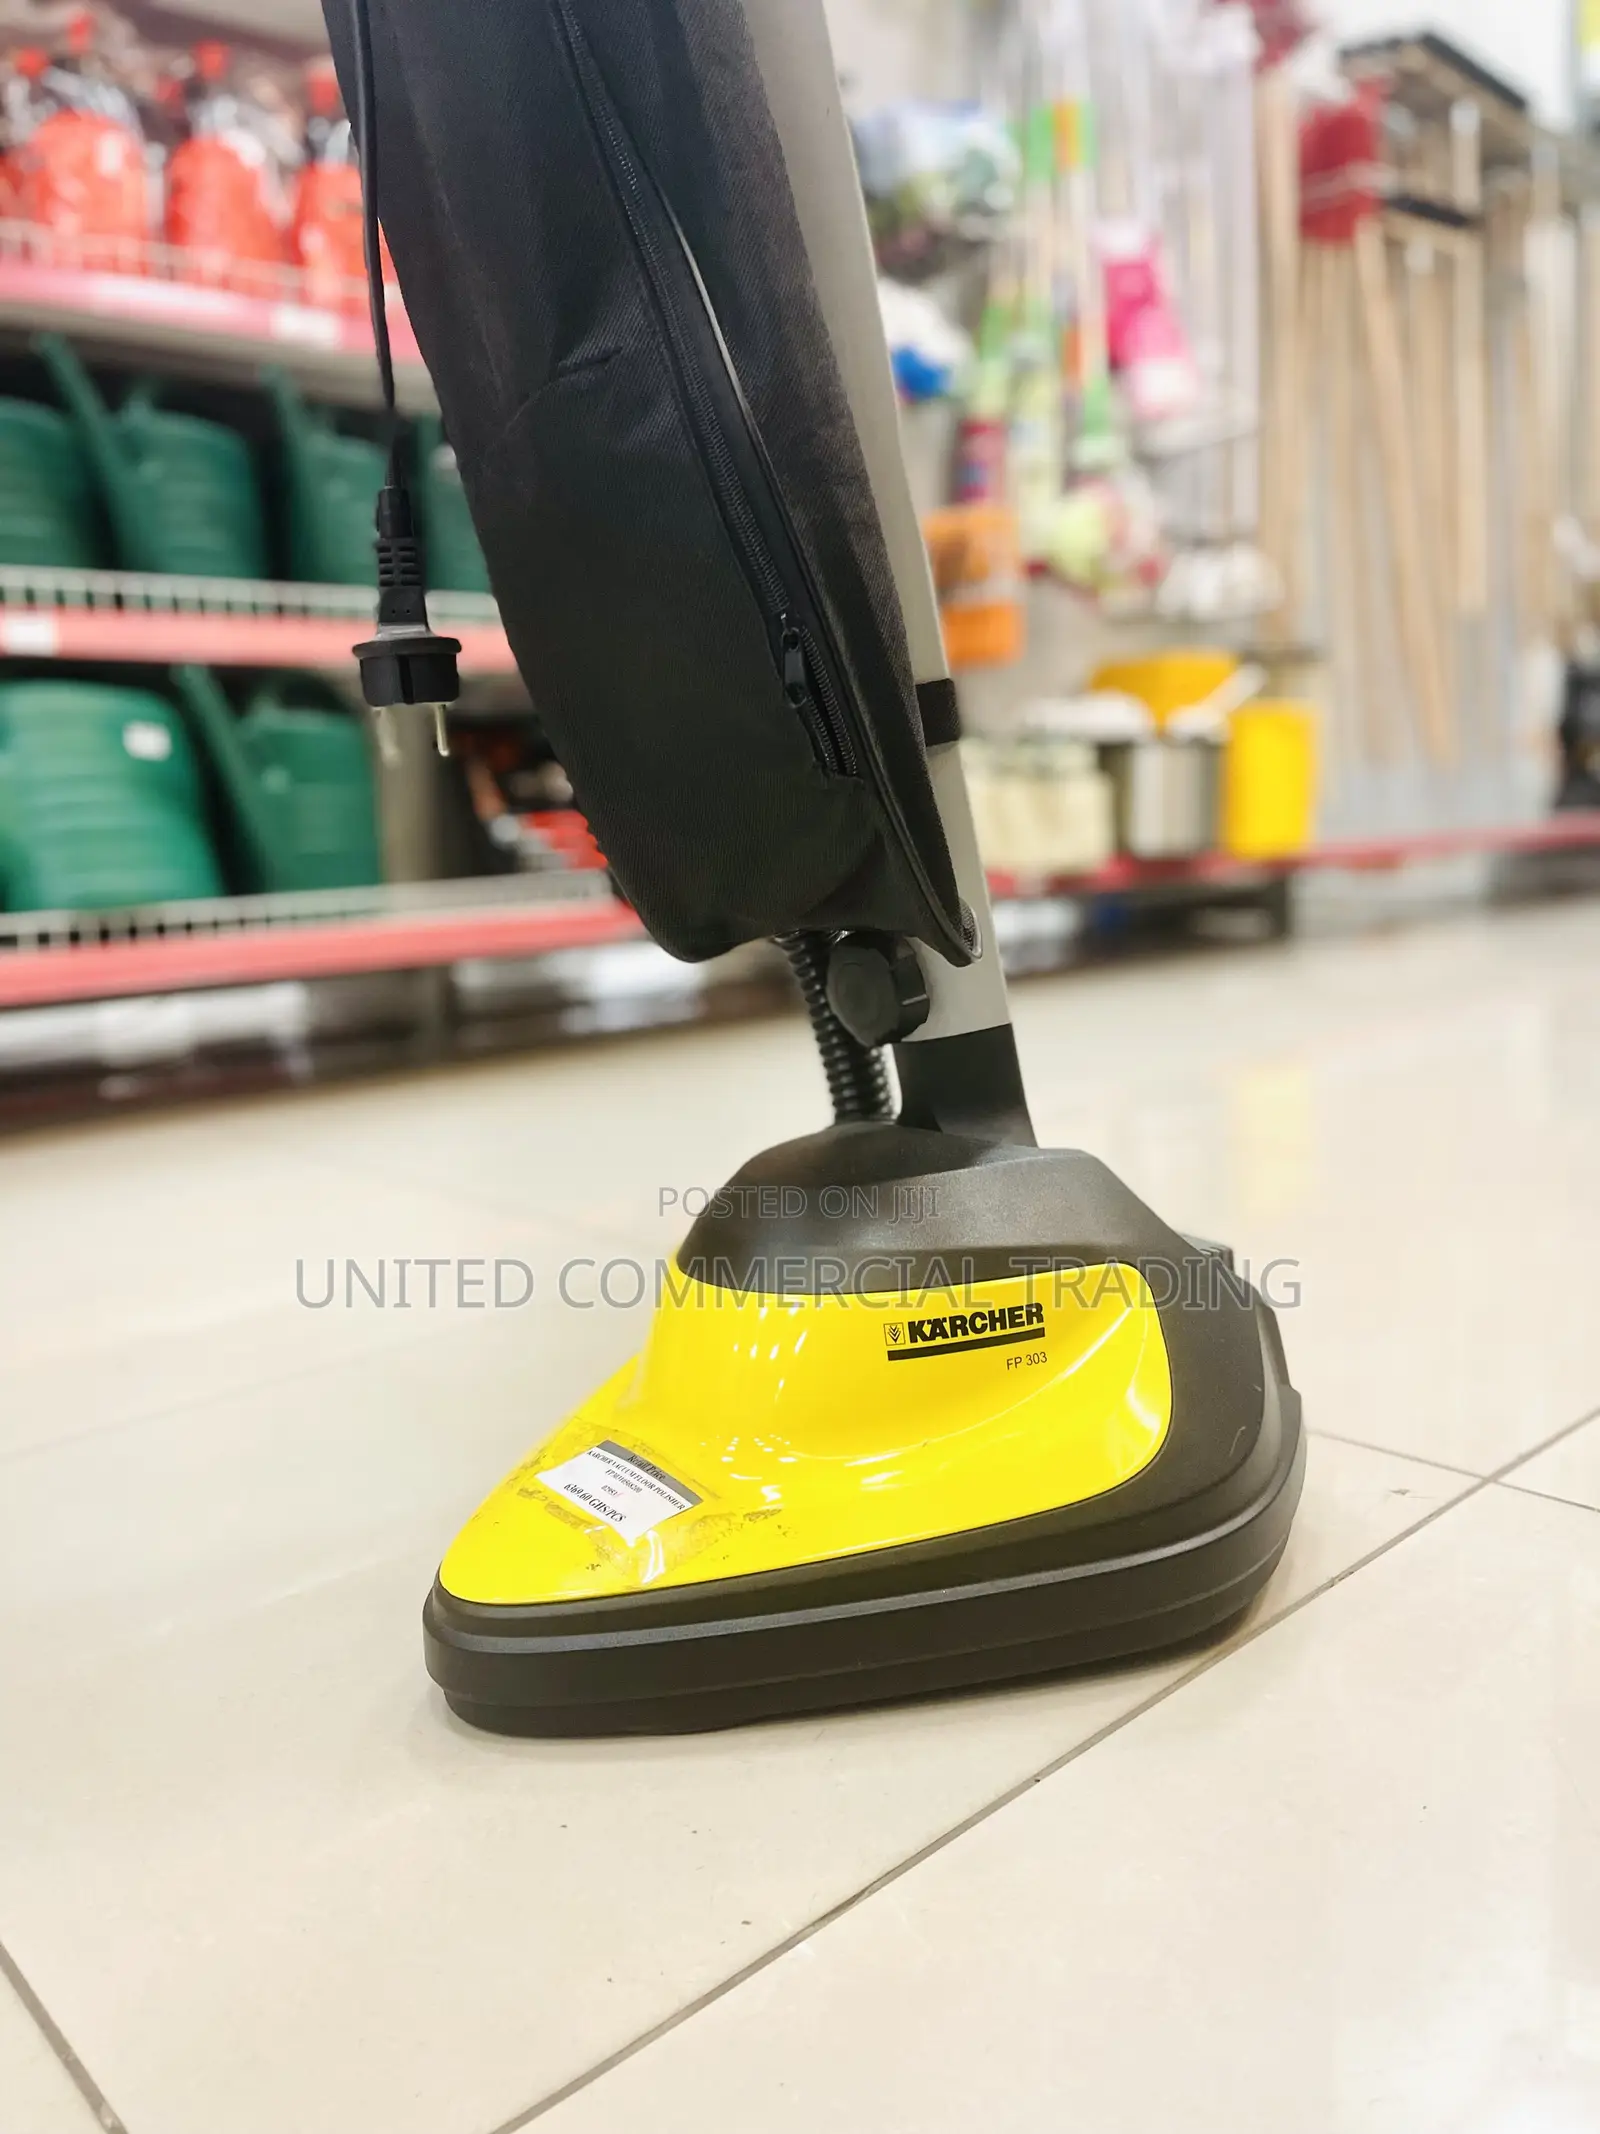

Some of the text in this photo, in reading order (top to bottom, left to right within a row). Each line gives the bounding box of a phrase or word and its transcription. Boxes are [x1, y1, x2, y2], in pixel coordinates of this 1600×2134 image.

[908, 1302, 1044, 1343] KÄRCHER
[1006, 1351, 1048, 1370] FP 303
[587, 1450, 614, 1464] KARCHER
[633, 1474, 656, 1489] FLOOR
[653, 1486, 686, 1510] POLISHER
[646, 1464, 666, 1479] Price
[588, 1498, 626, 1522] GHS/PCS
